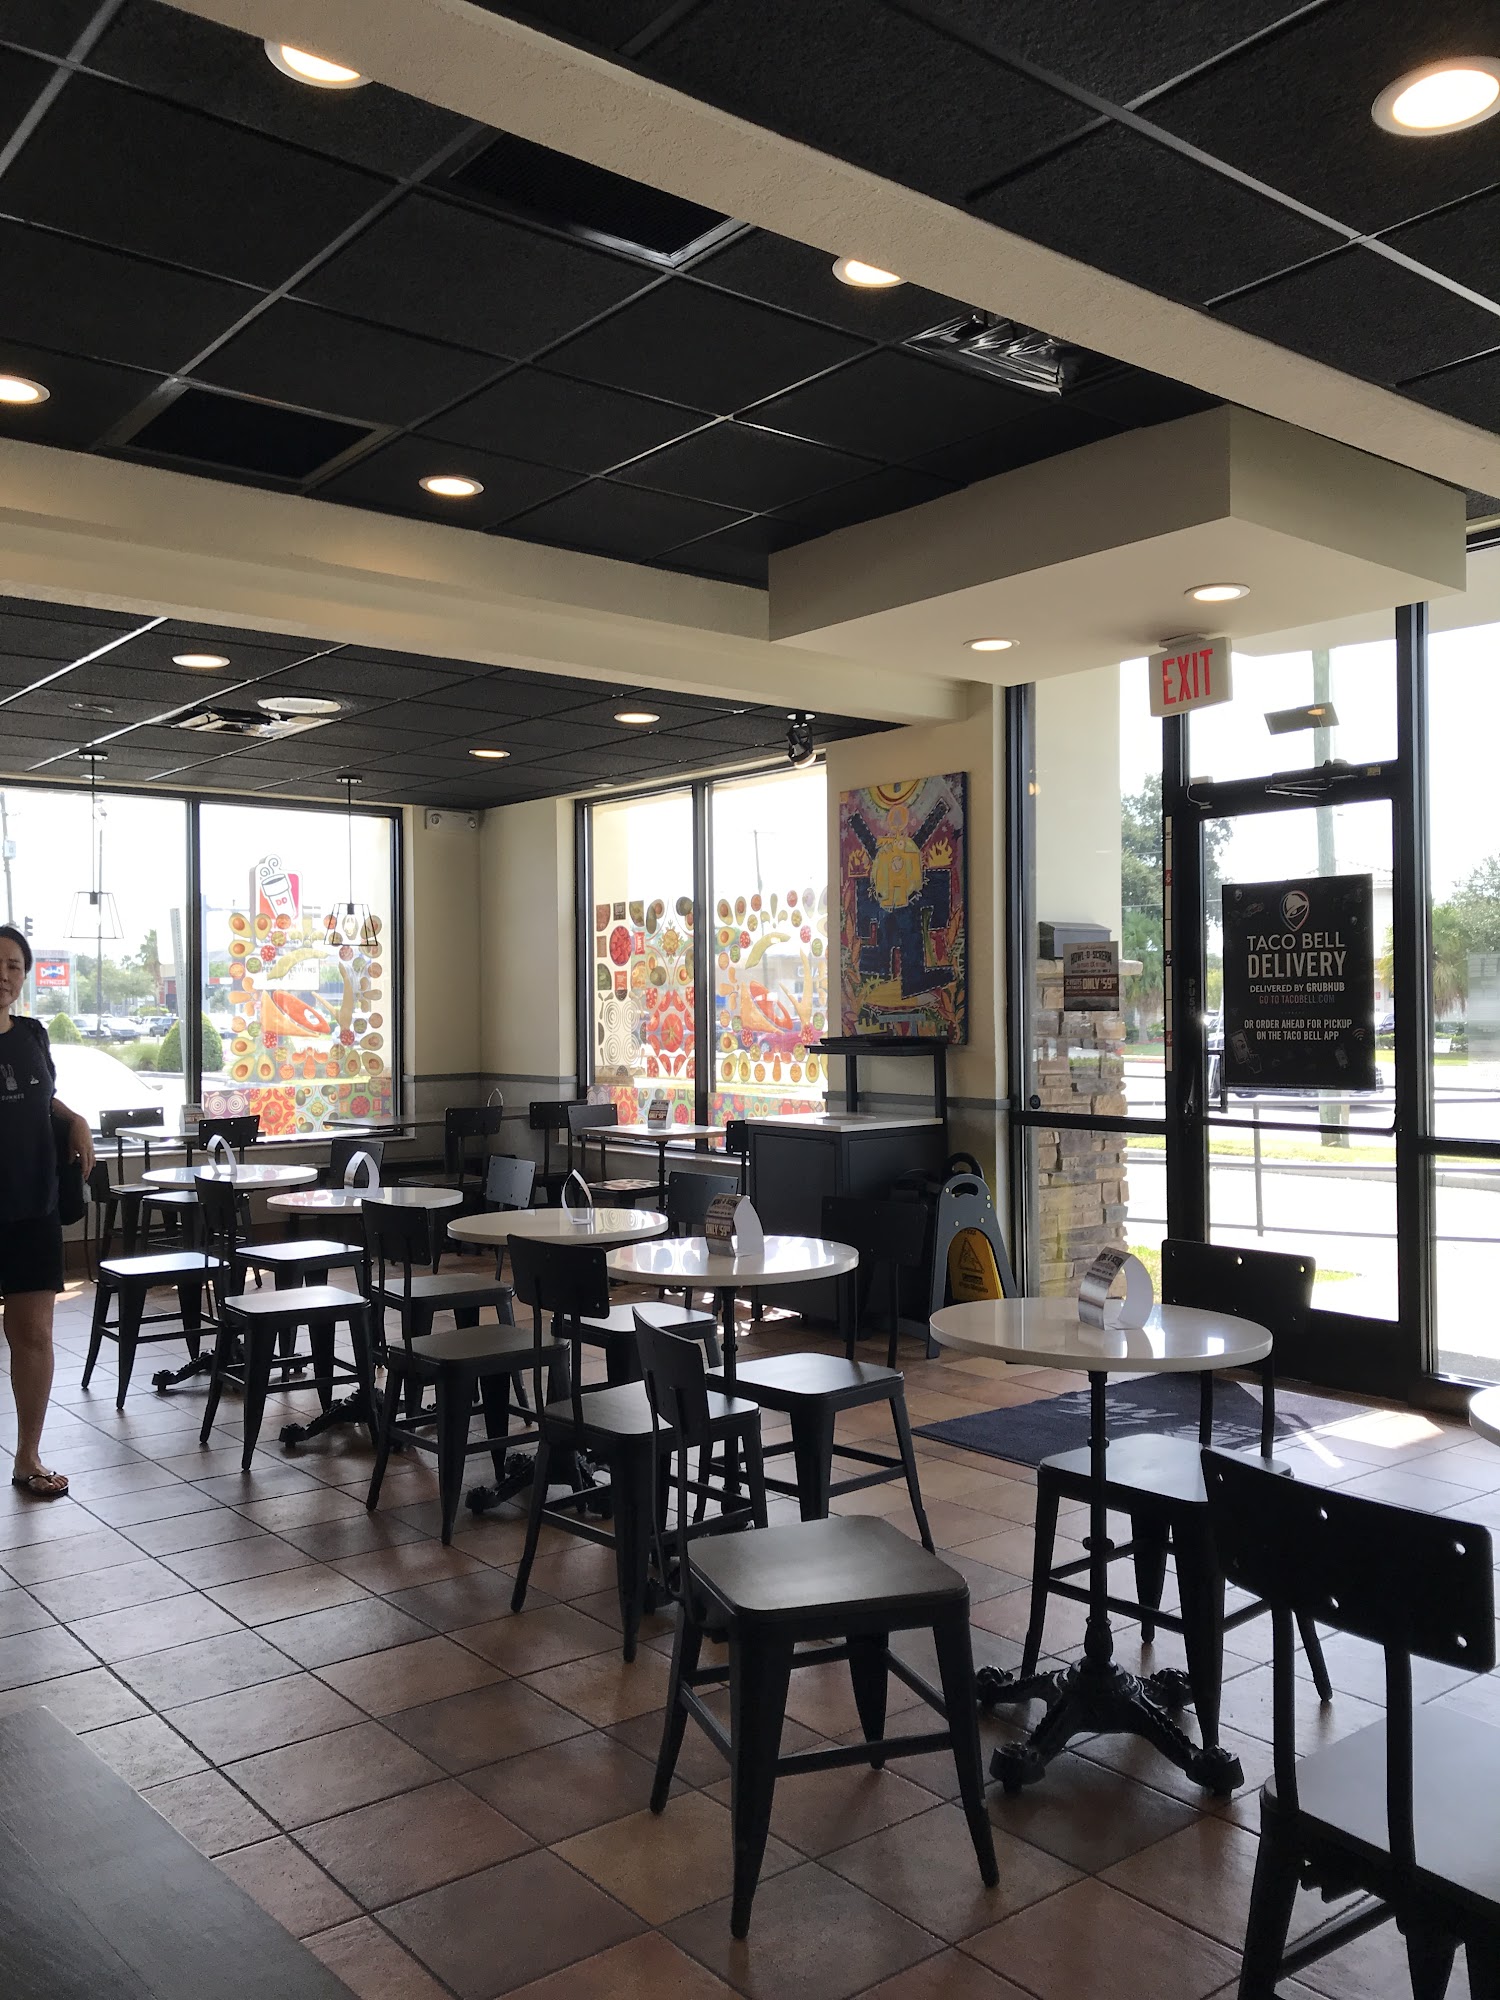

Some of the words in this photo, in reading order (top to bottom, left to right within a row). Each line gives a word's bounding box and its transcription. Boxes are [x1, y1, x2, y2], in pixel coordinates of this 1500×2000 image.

[1162, 648, 1213, 705] EXIT
[276, 897, 287, 906] DD
[1247, 934, 1296, 951] TACO
[1302, 932, 1345, 949] BELL
[1248, 951, 1347, 978] DELIVERY
[1082, 978, 1100, 989] ONLY
[1294, 984, 1304, 992] BY
[1306, 982, 1345, 992] GRUBHUB
[1260, 995, 1268, 1004] GO
[1271, 995, 1279, 1004] TO
[1282, 995, 1335, 1004] TACOBELL.COM
[1244, 1020, 1254, 1028] OR
[1256, 1020, 1279, 1028] ORDER
[1281, 1020, 1305, 1028] AHEAD
[1307, 1020, 1322, 1028] FOR
[1324, 1019, 1352, 1028] PICKUP
[1257, 1031, 1266, 1040] ON
[1268, 1031, 1281, 1040] THE
[1283, 1031, 1300, 1040] TACO
[1304, 1031, 1322, 1040] BELL
[1324, 1031, 1339, 1040] APP
